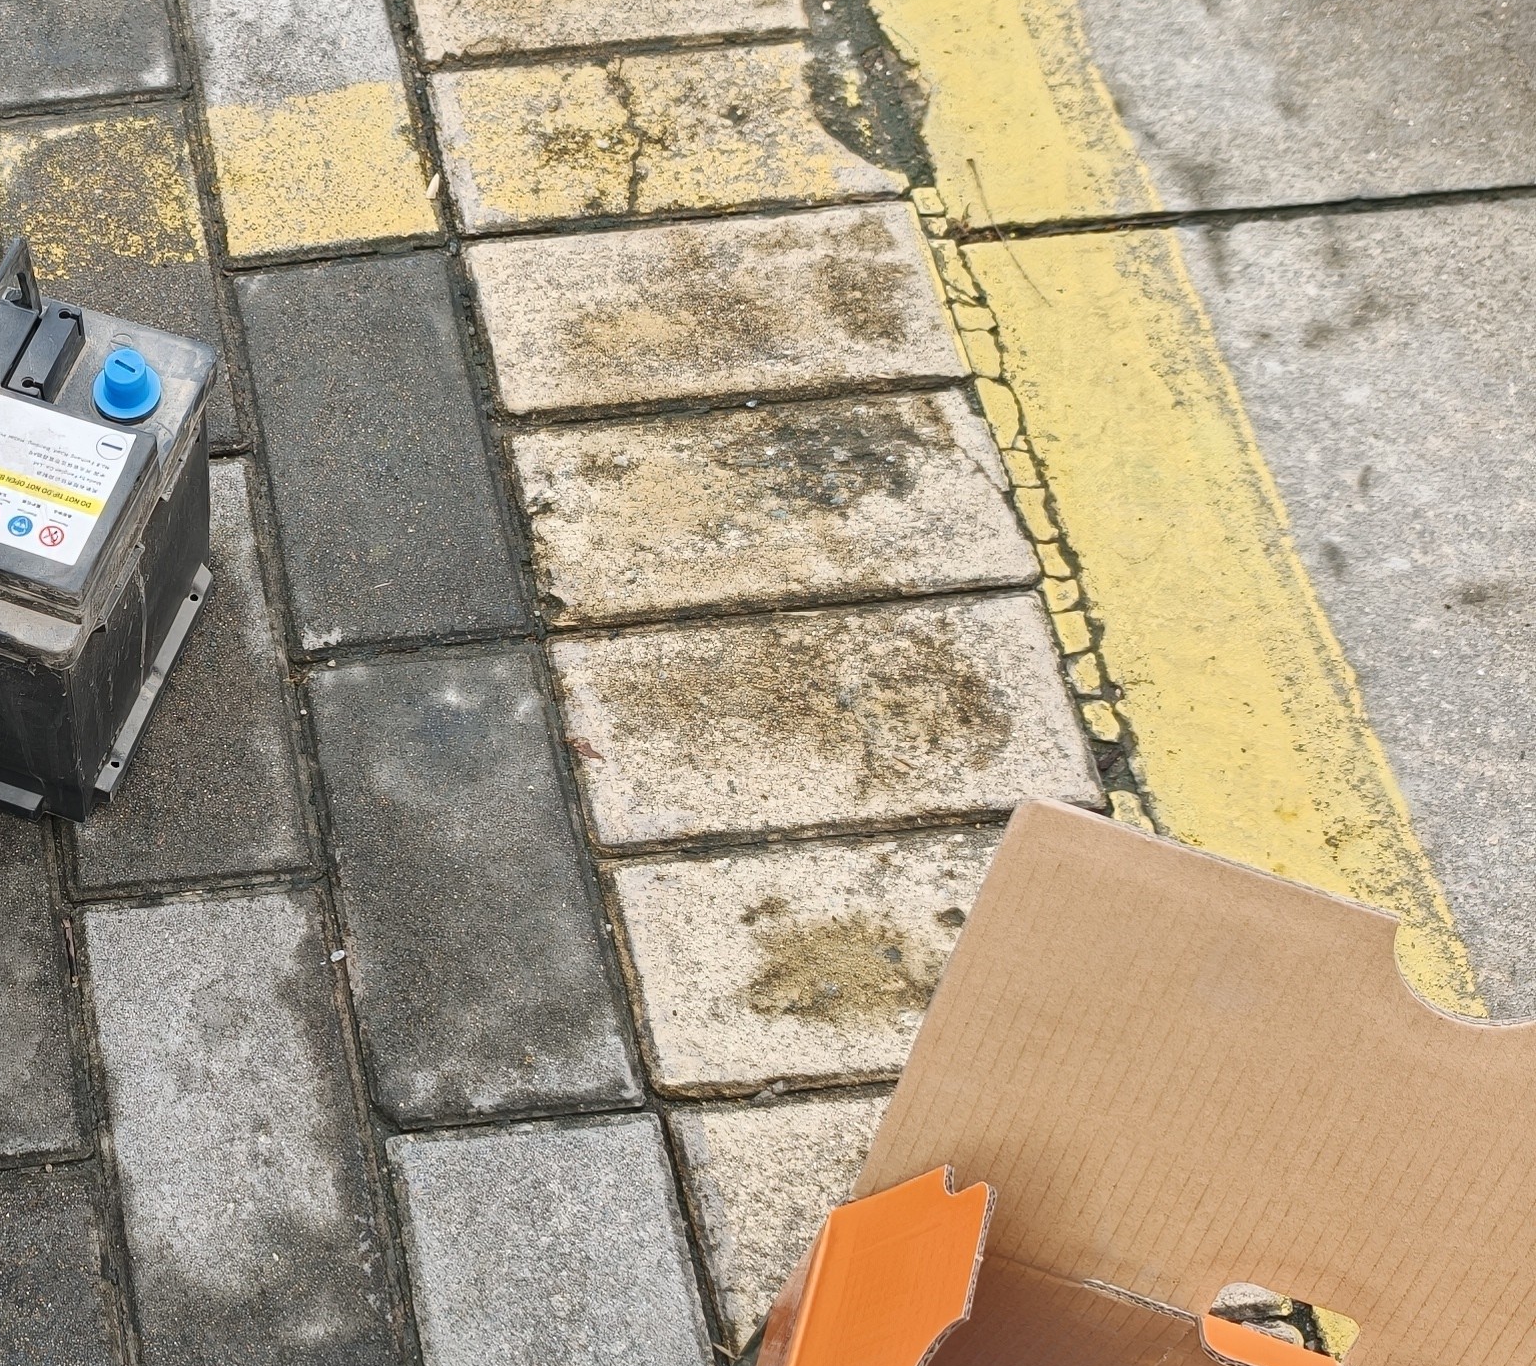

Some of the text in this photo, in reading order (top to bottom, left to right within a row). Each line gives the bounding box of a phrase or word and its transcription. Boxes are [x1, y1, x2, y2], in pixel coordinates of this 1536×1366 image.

[5, 475, 25, 487] OPEN
[25, 482, 41, 492] NOT
[64, 494, 80, 505] NOT
[80, 499, 92, 508] DO
